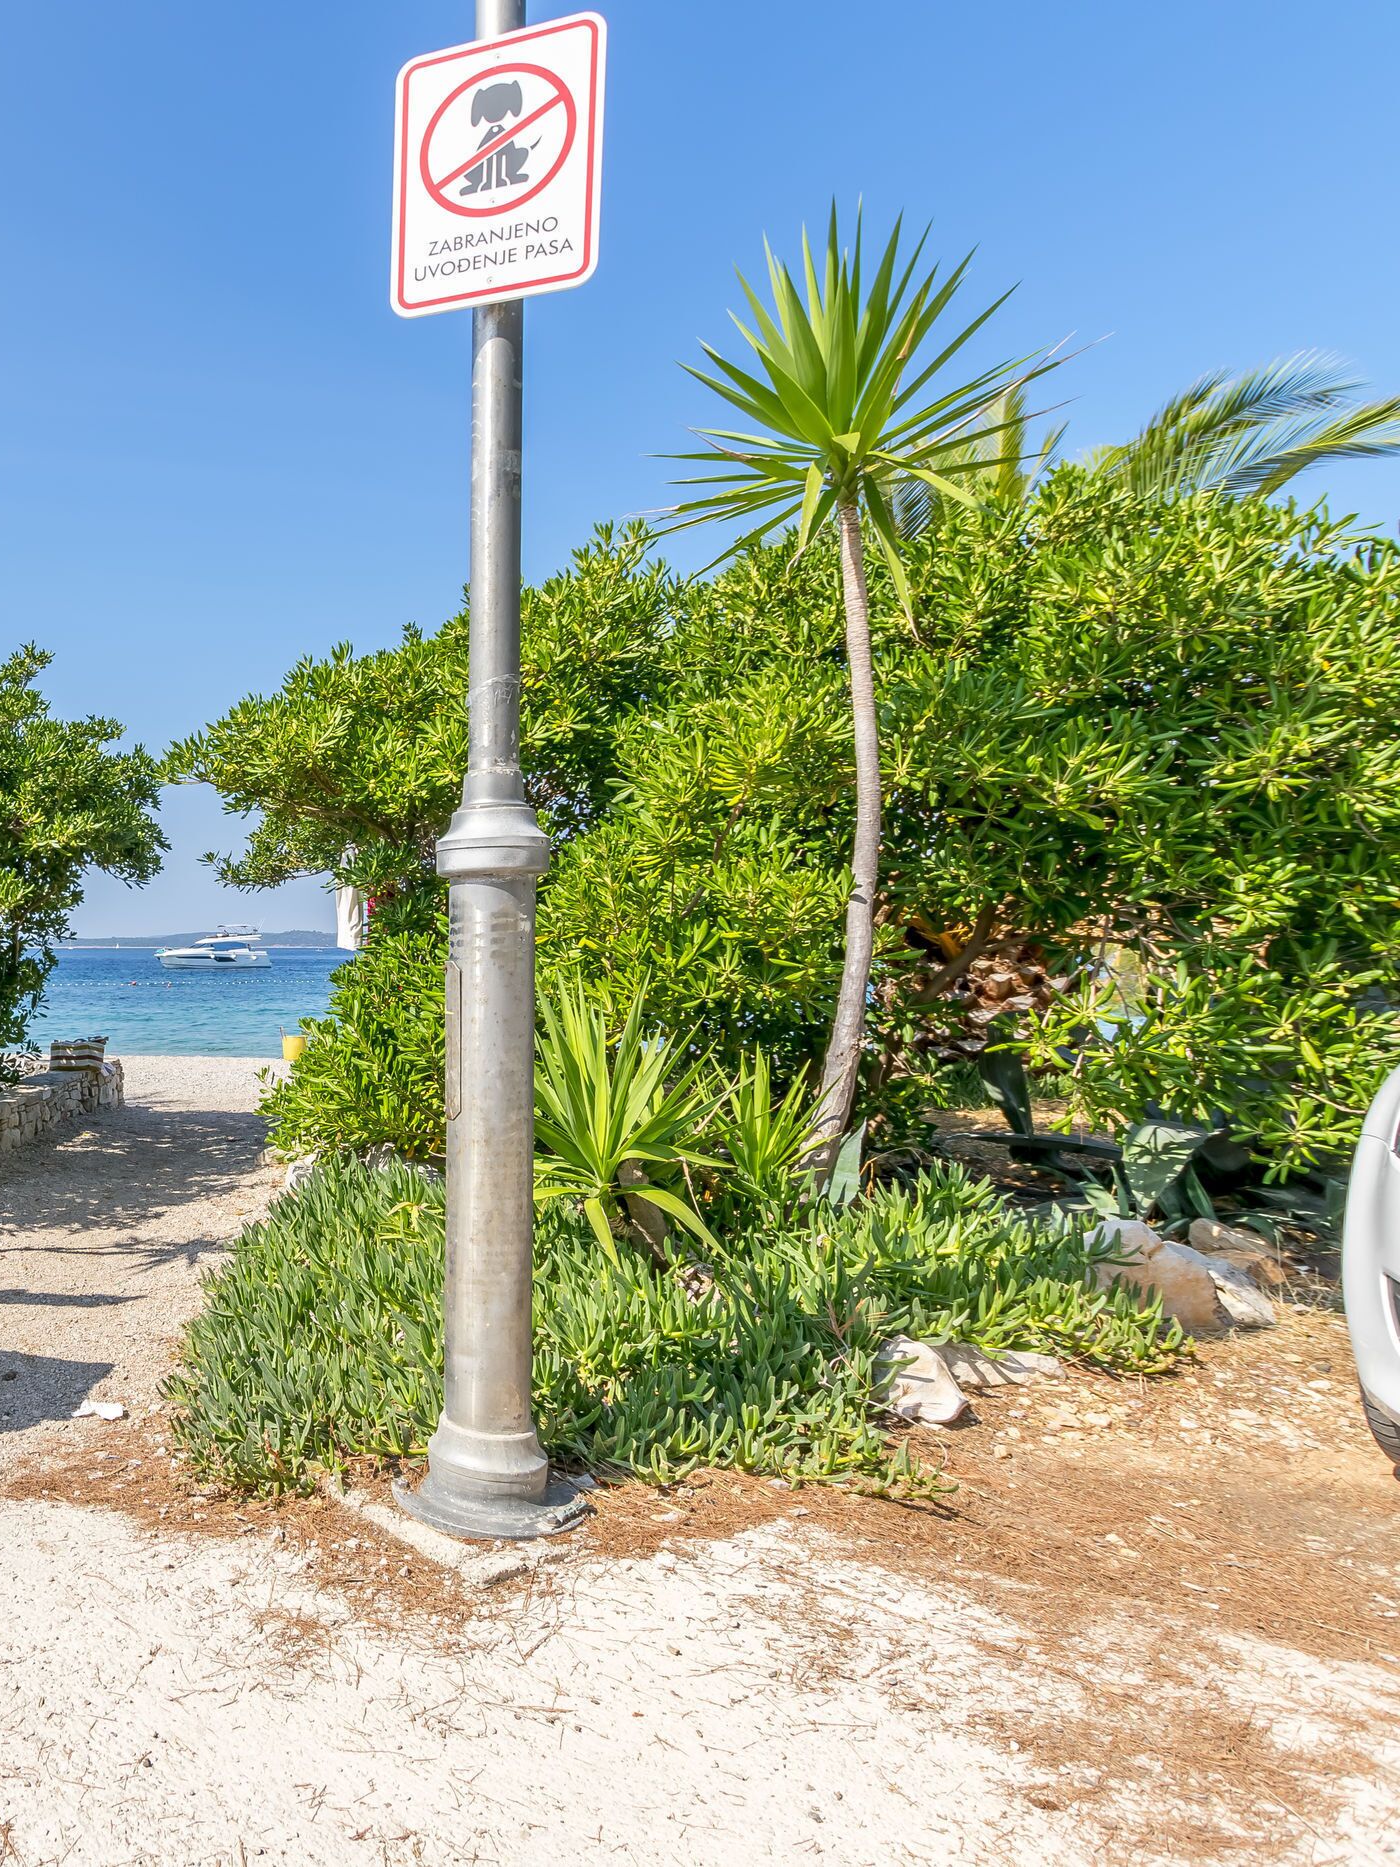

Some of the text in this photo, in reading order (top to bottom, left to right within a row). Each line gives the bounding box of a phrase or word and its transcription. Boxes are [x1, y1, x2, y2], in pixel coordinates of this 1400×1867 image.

[428, 216, 558, 256] ZABRANJENO
[414, 238, 573, 281] UVOĐENJE PASA
